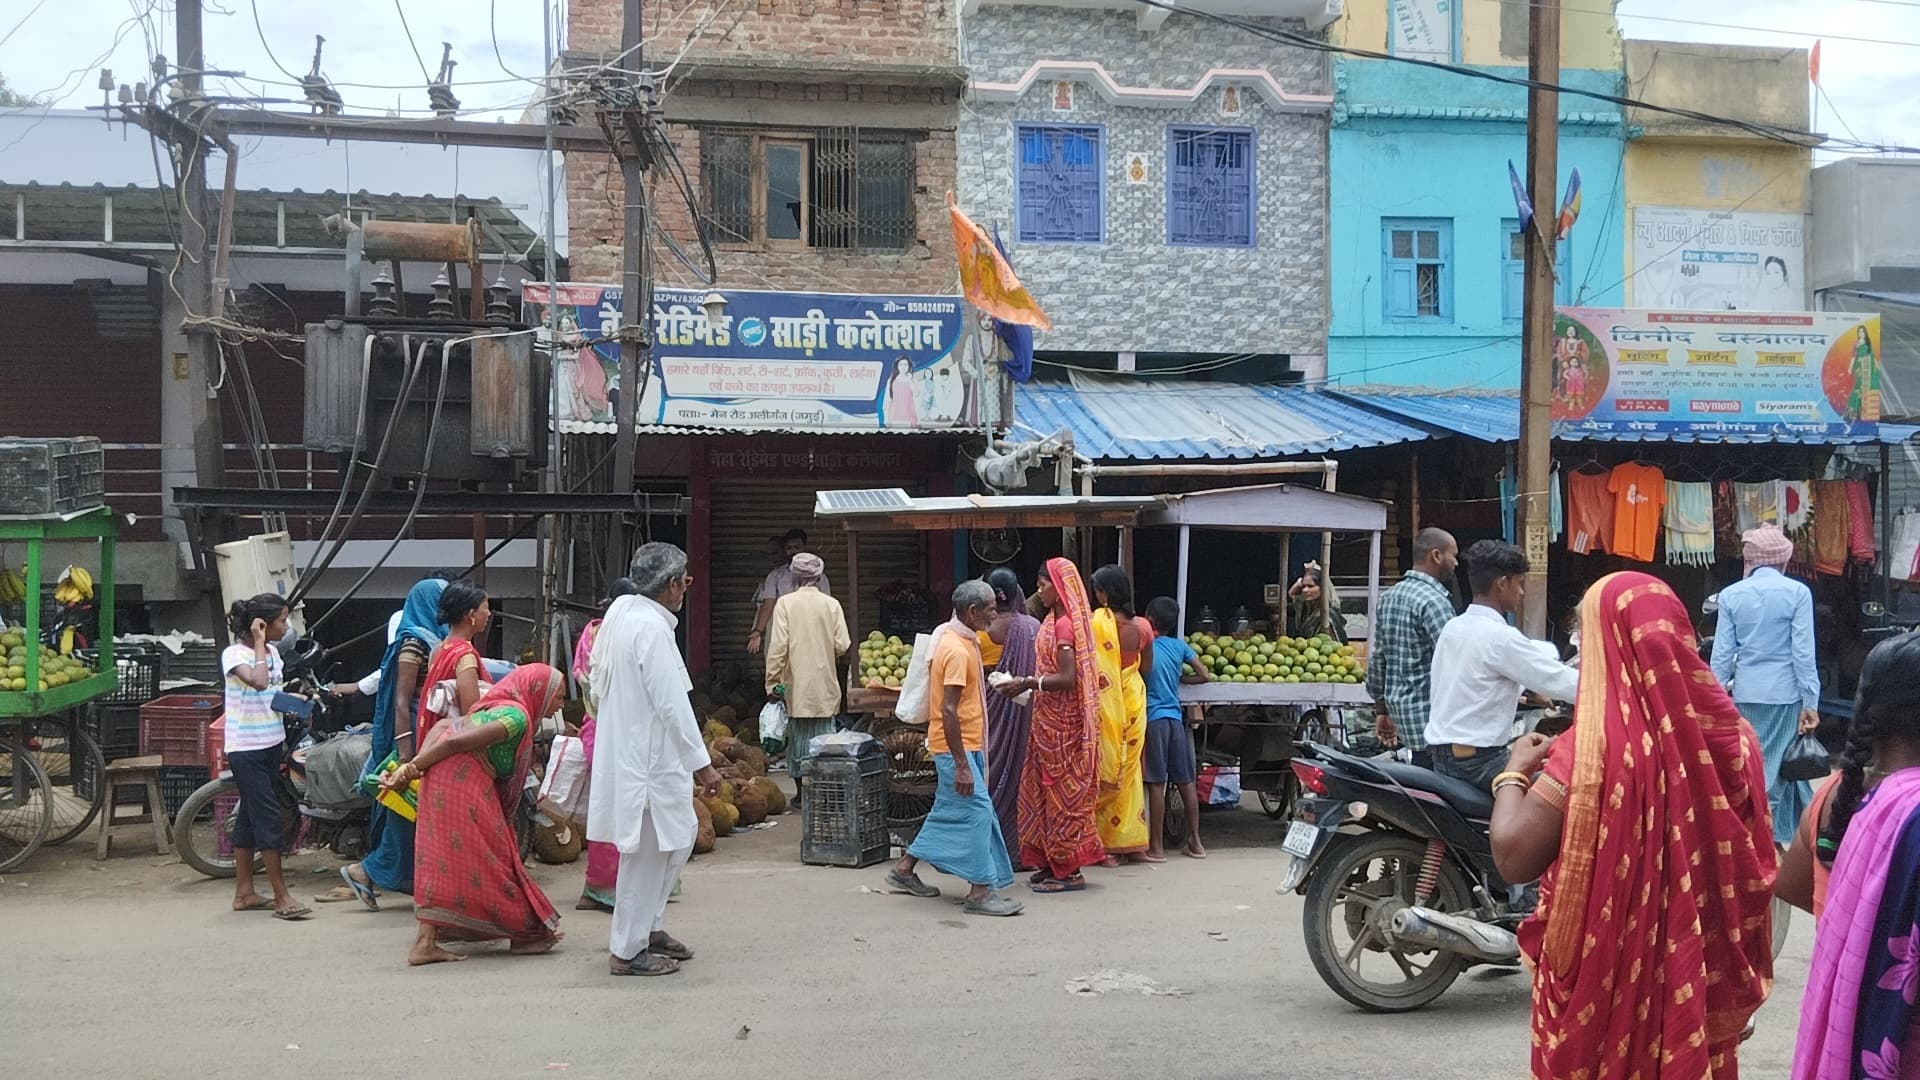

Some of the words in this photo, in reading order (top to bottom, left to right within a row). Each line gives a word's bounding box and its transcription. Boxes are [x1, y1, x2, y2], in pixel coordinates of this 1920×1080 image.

[1657, 217, 1691, 242] आदर्श
[770, 308, 831, 357] साड़ी
[833, 310, 944, 351] कलेक्शन
[1610, 325, 1695, 344] विनोद
[1716, 331, 1829, 346] वस्त्रालय
[666, 364, 690, 376] हमारे
[1619, 403, 1665, 411] VIMAL
[1692, 400, 1740, 412] Raymond
[709, 408, 728, 420] मेन
[730, 408, 746, 420] रोड
[749, 408, 788, 421] अलीगंज
[1627, 420, 1658, 431] रोड
[1689, 420, 1757, 432] अलीगंज
